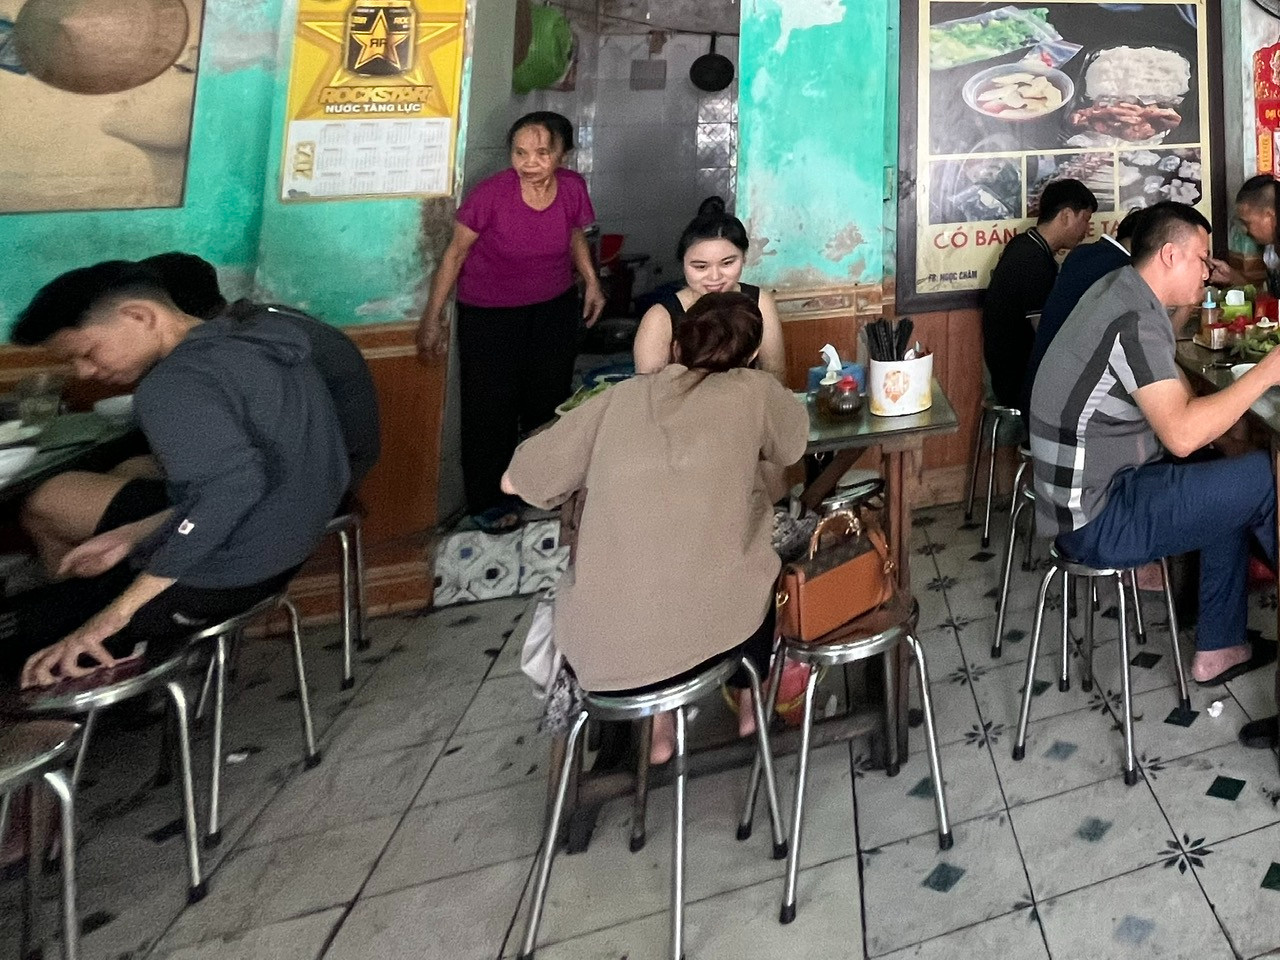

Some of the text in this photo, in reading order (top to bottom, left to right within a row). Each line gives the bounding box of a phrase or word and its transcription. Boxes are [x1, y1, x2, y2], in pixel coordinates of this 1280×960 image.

[318, 86, 432, 104] ROCKSTAR
[934, 225, 968, 250] CÓ
[975, 223, 1018, 246] BÁN
